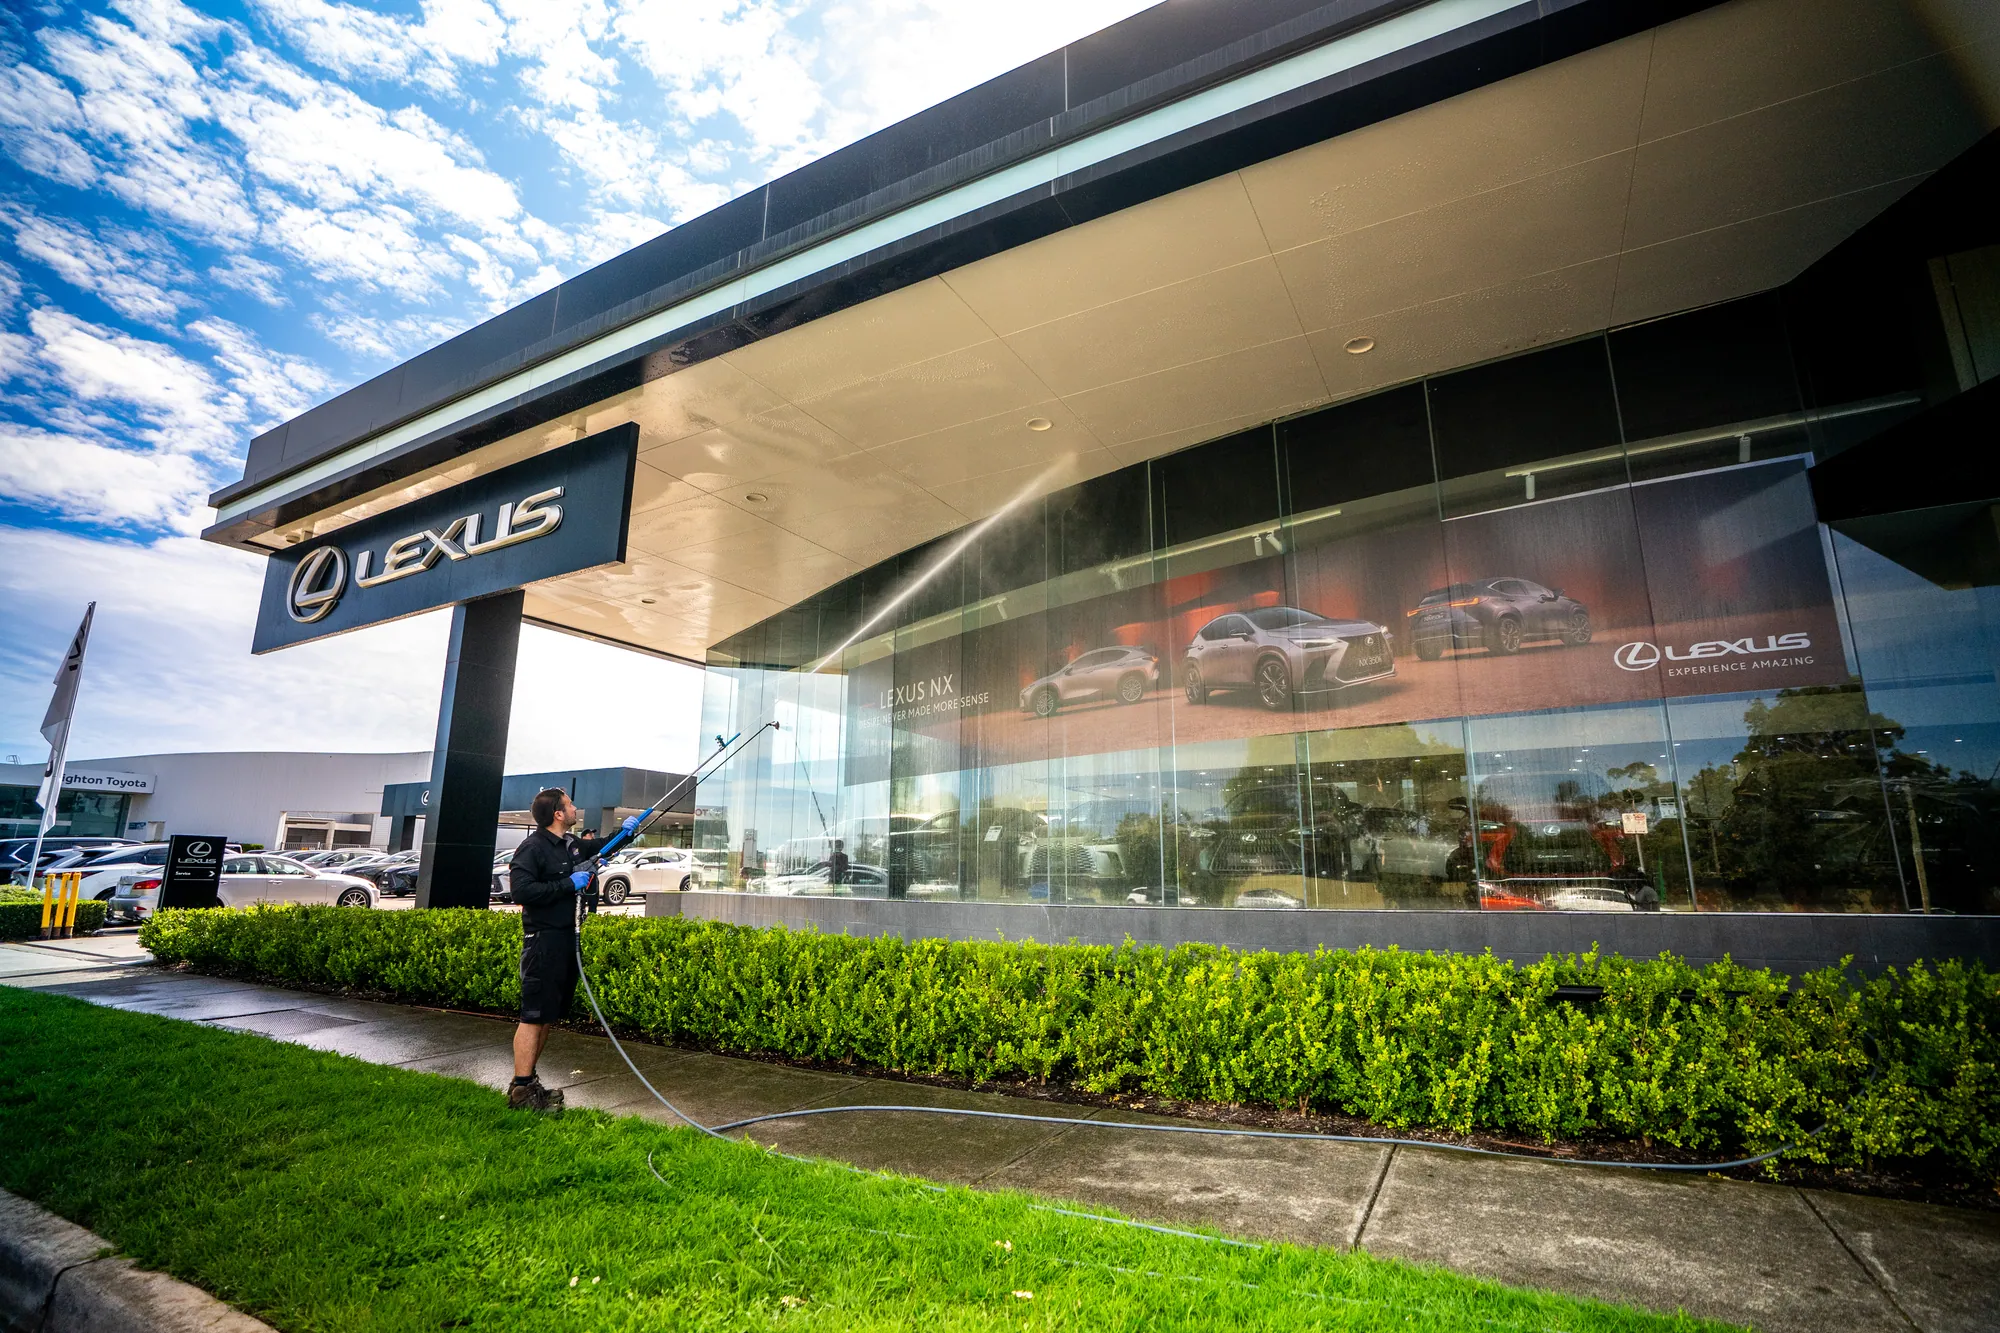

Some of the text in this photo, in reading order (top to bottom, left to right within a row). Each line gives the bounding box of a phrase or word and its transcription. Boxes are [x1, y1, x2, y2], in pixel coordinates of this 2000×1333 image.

[355, 485, 566, 588] LEXUS
[1665, 632, 1811, 661] LEXUS
[1668, 655, 1815, 677] EXPERIENCE AMAZING
[880, 673, 953, 710] LEXUS NX
[882, 709, 907, 724] NEVER
[908, 704, 931, 719] MADE
[933, 698, 958, 713] MORE
[960, 692, 989, 709] SENSE
[62, 773, 147, 788] ighton Toyota
